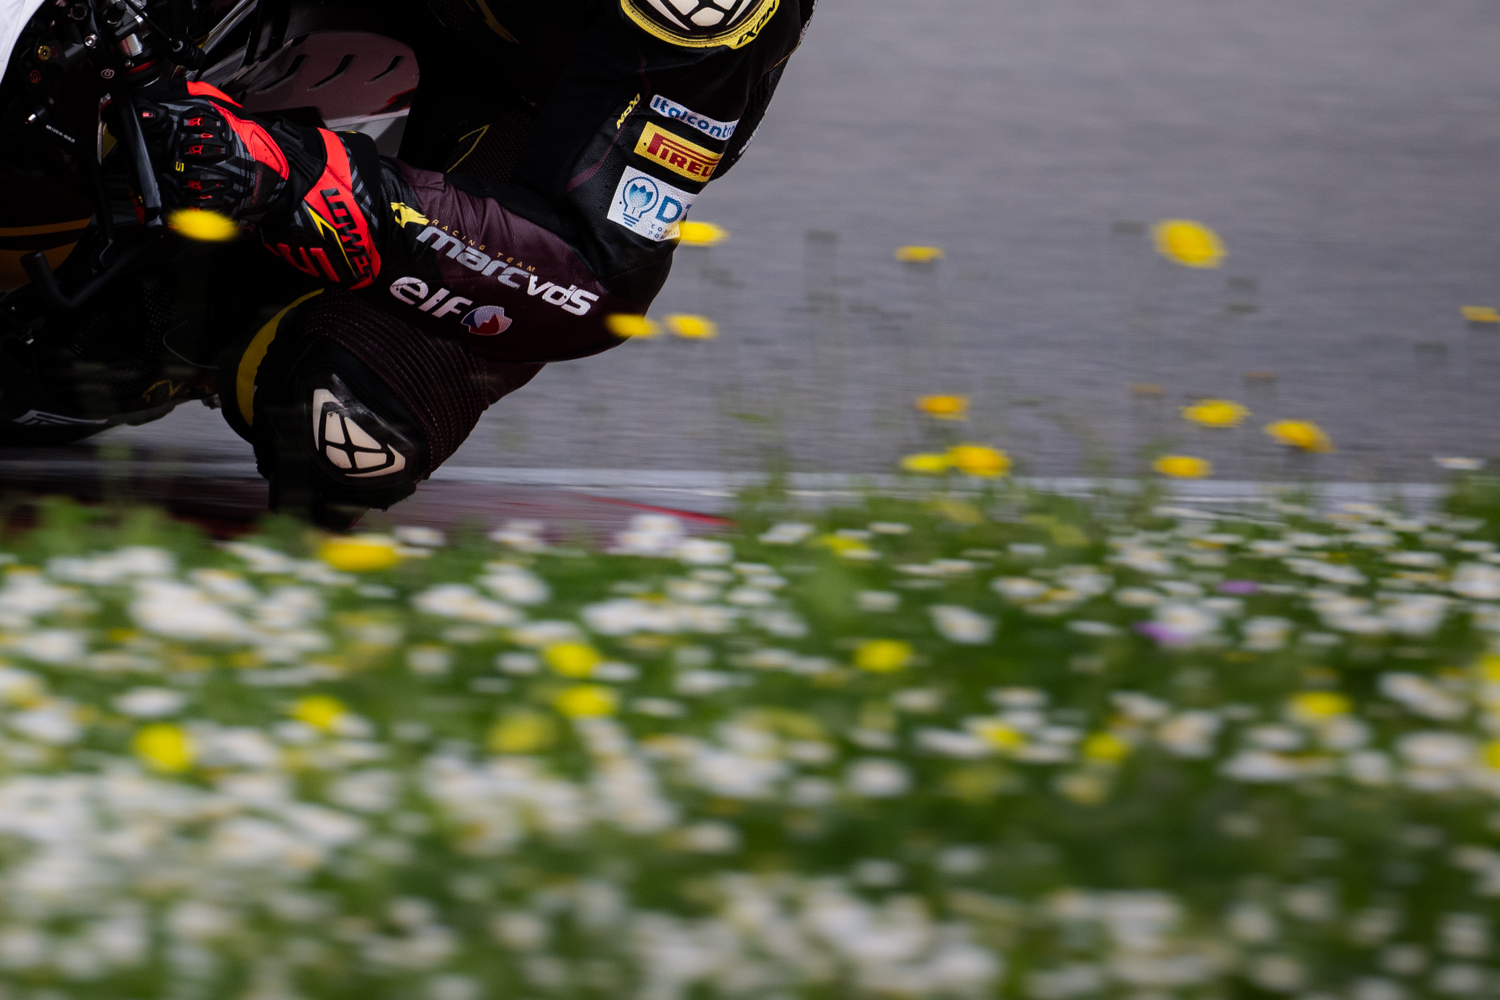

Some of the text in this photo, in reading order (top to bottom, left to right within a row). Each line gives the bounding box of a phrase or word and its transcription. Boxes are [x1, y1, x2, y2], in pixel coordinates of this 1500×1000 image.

[736, 0, 777, 46] IXON
[615, 92, 642, 130] IXON
[319, 187, 377, 281] LOWES
[431, 218, 537, 273] RACING TEAM
[416, 226, 600, 316] marcvds
[389, 276, 474, 319] elf
